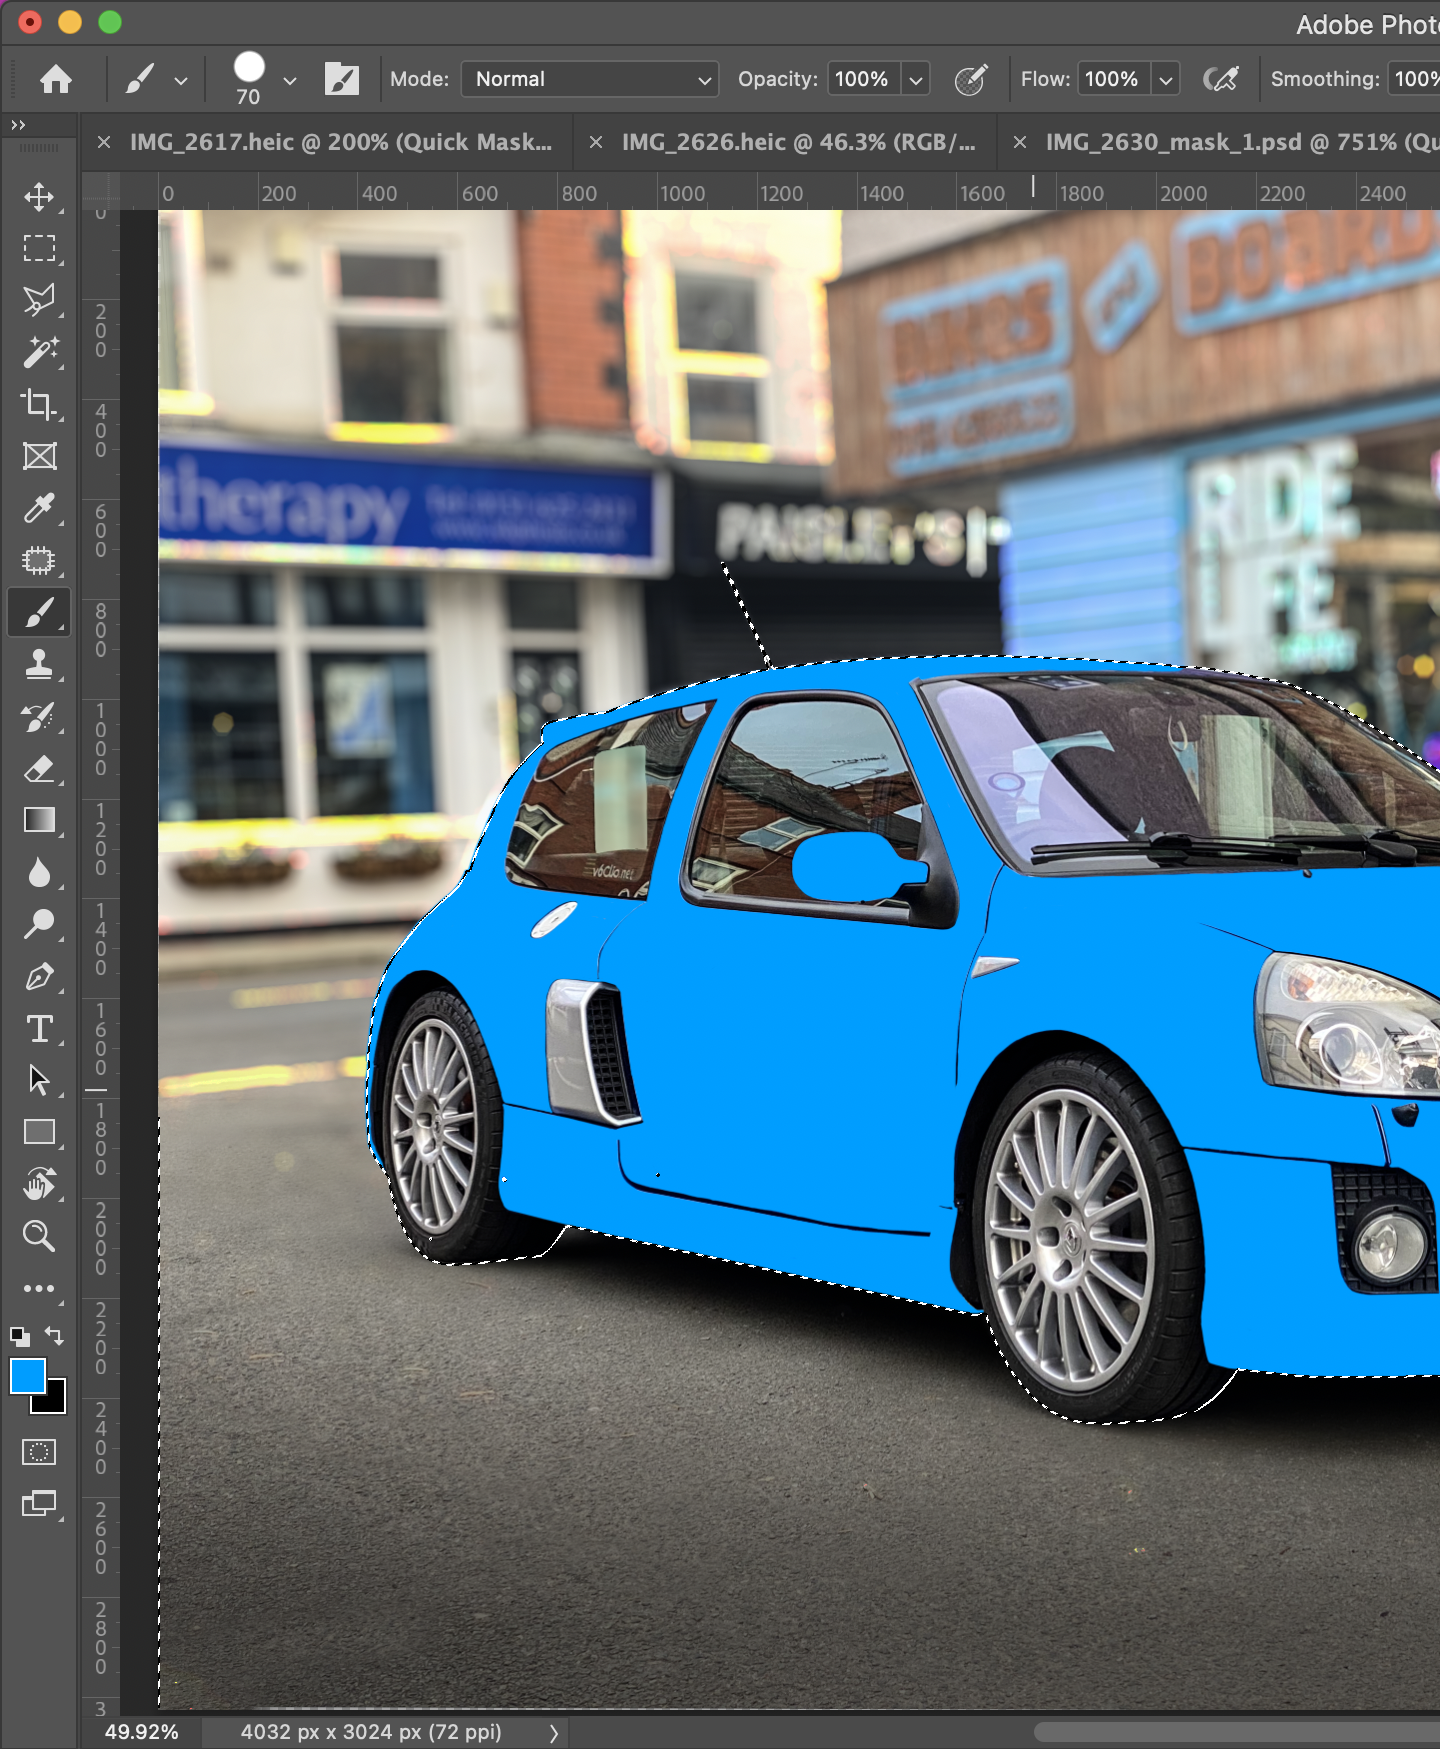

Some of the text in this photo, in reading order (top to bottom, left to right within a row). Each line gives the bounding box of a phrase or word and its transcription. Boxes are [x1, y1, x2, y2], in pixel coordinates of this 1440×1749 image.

[1296, 14, 1373, 35] Adobe
[391, 70, 448, 86] Mode:
[477, 70, 544, 86] Normal
[739, 70, 817, 90] Opacity:
[836, 71, 888, 87] 100%
[1022, 70, 1070, 86] Flow:
[1086, 71, 1138, 87] 100%
[1272, 70, 1379, 90] Smoothing:
[237, 89, 260, 105] 70
[131, 132, 294, 154] IMG_2617.heic
[329, 133, 388, 151] 200%
[396, 132, 469, 153] (Quick
[623, 132, 786, 154] IMG_2626.heic
[820, 133, 886, 151] 46.3%
[1047, 132, 1301, 155] IMG_2630_mask_1.psd
[1338, 133, 1397, 151] 751%
[163, 186, 174, 201] 0
[262, 186, 296, 201] 200
[362, 186, 397, 201] 400
[463, 186, 498, 201] 600
[563, 186, 597, 201] 800
[661, 186, 705, 201] 1000
[761, 186, 803, 201] 1200
[861, 186, 904, 201] 1400
[961, 186, 1005, 201] 1600
[1061, 186, 1104, 201] 1800
[1161, 186, 1207, 201] 2000
[1260, 186, 1305, 201] 2200
[1360, 186, 1406, 201] 2400
[96, 304, 106, 357] 200
[95, 404, 107, 457] 400
[1197, 437, 1359, 545] RIDE
[96, 504, 106, 557] 600
[96, 603, 106, 657] 800
[96, 703, 106, 775] 1000
[96, 803, 106, 875] 1200
[95, 903, 107, 975] 1400
[96, 1003, 106, 1075] 1600
[96, 1103, 106, 1175] 1800
[96, 1202, 106, 1275] 2000
[96, 1302, 106, 1374] 2200
[95, 1402, 107, 1474] 2400
[96, 1502, 106, 1574] 2600
[96, 1602, 106, 1674] 2800
[105, 1724, 178, 1740] 49.92%
[241, 1723, 501, 1743] 4032 px x 3024 px (72 ppi)
